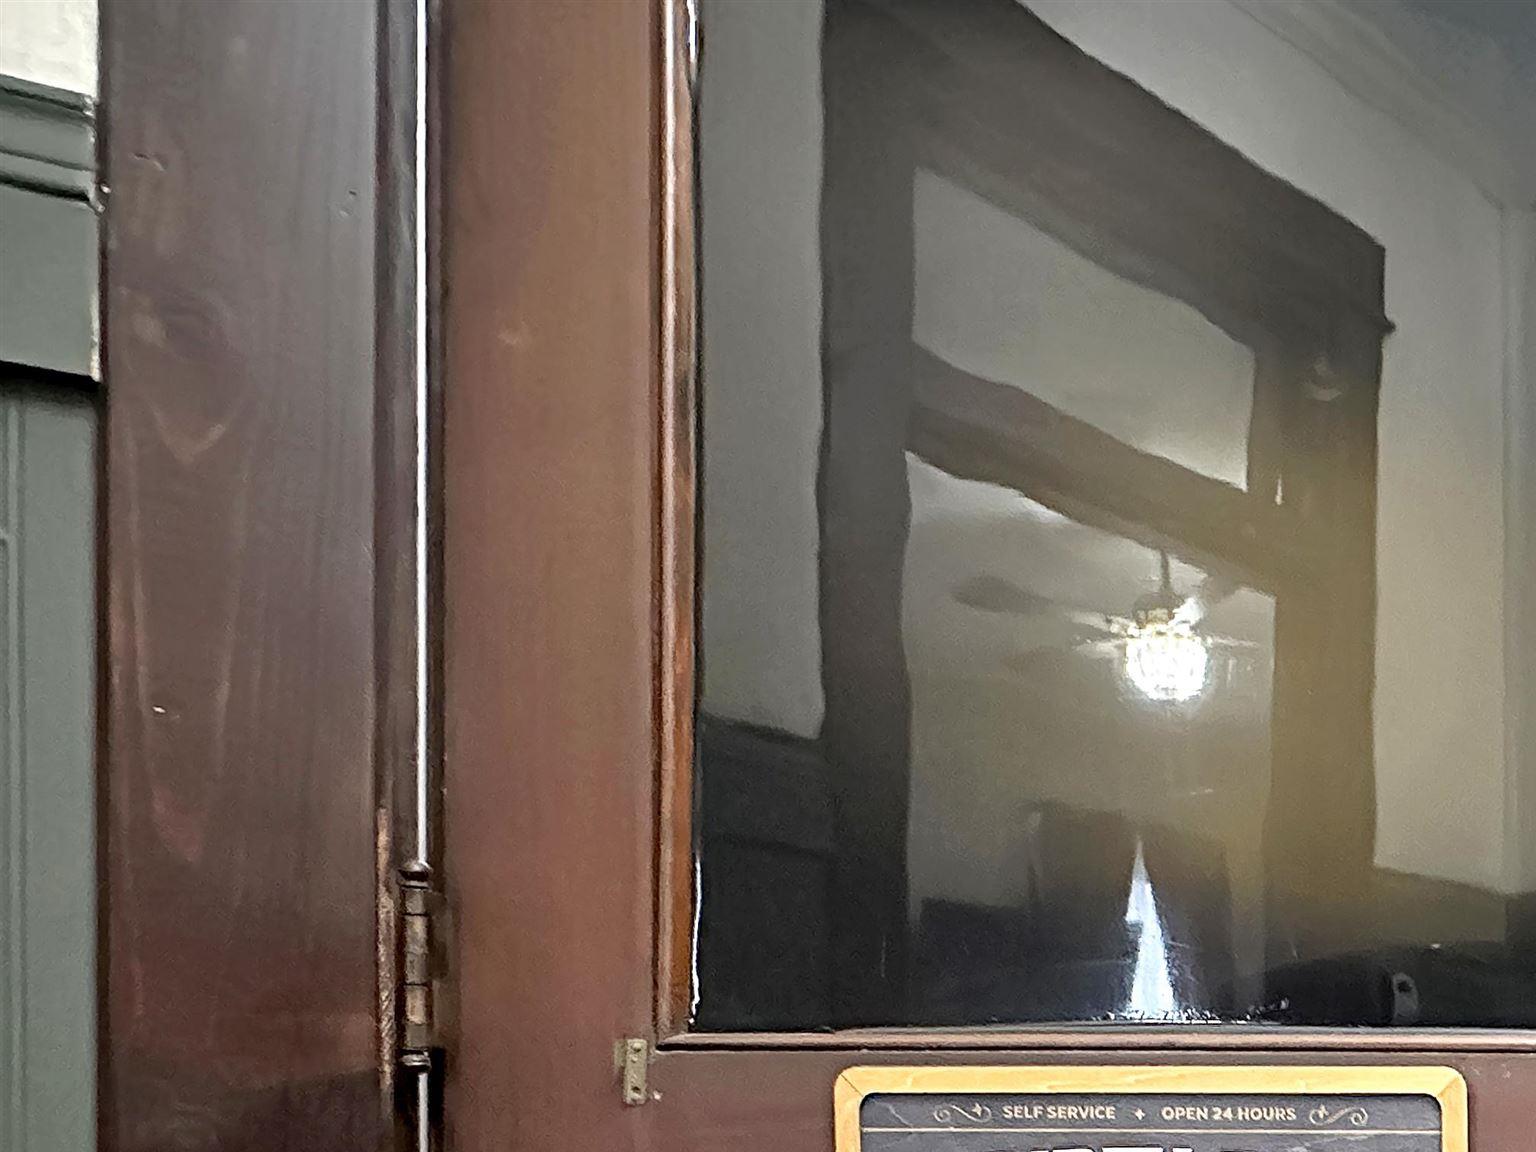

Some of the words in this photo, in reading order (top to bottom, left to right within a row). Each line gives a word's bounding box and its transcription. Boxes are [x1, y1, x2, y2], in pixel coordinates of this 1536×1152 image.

[1001, 1104, 1044, 1120] SELF
[1046, 1104, 1117, 1121] SERVICE
[1160, 1105, 1208, 1121] OPEN
[1211, 1105, 1234, 1121] 24
[1237, 1106, 1298, 1122] HOURS
